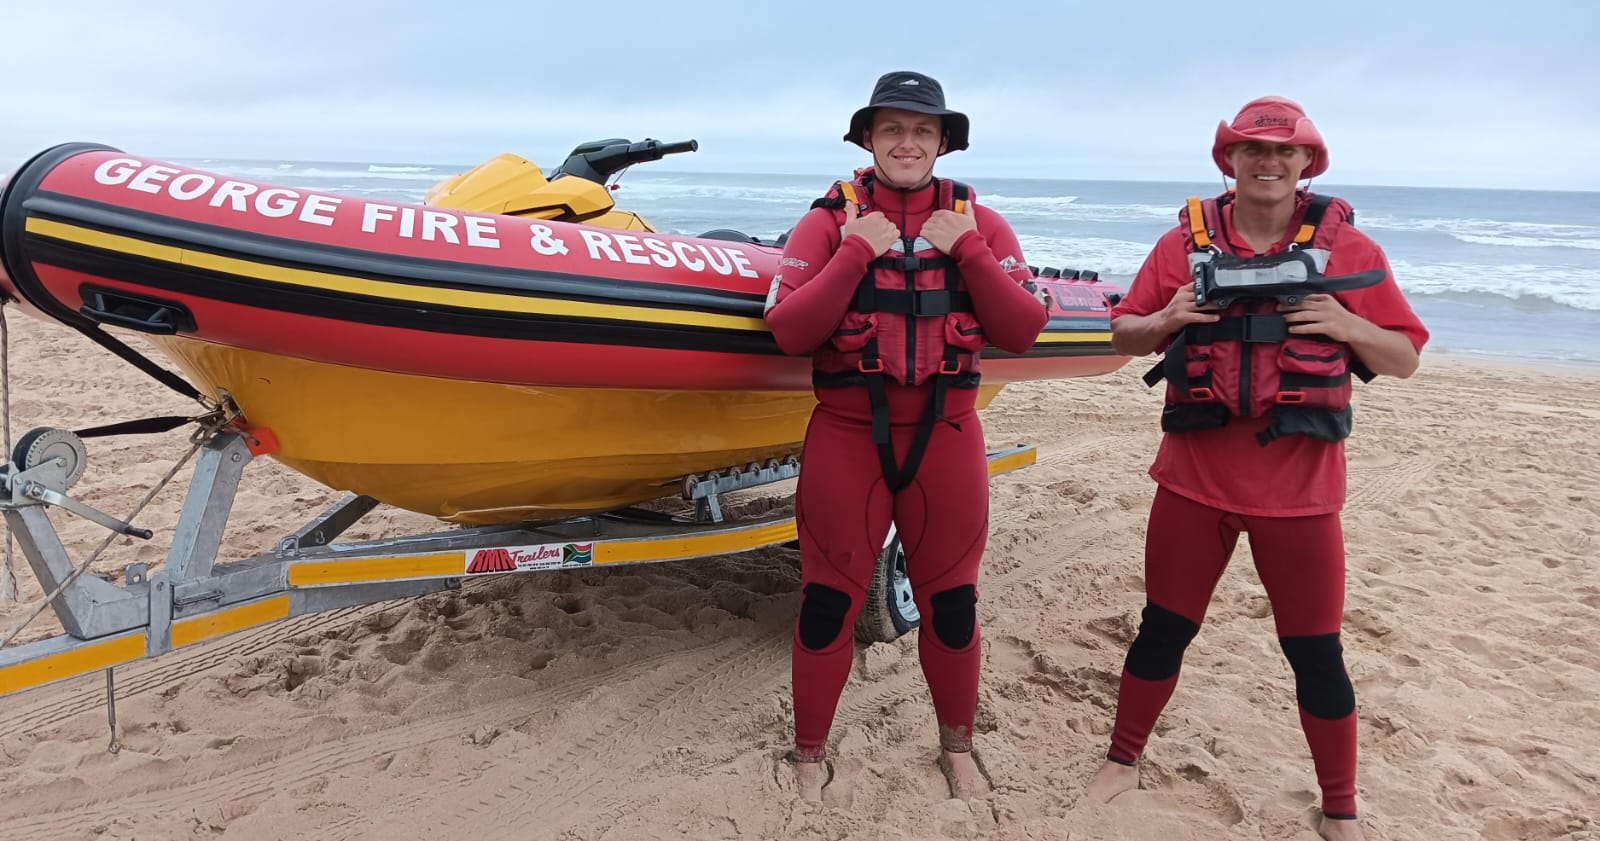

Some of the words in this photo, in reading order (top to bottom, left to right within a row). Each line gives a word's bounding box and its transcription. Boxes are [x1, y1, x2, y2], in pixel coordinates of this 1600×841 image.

[94, 158, 342, 226] GEORGE
[361, 202, 501, 249] FIRE
[529, 224, 570, 256] &
[578, 229, 759, 279] RESCUE
[510, 546, 560, 562] Trailers
